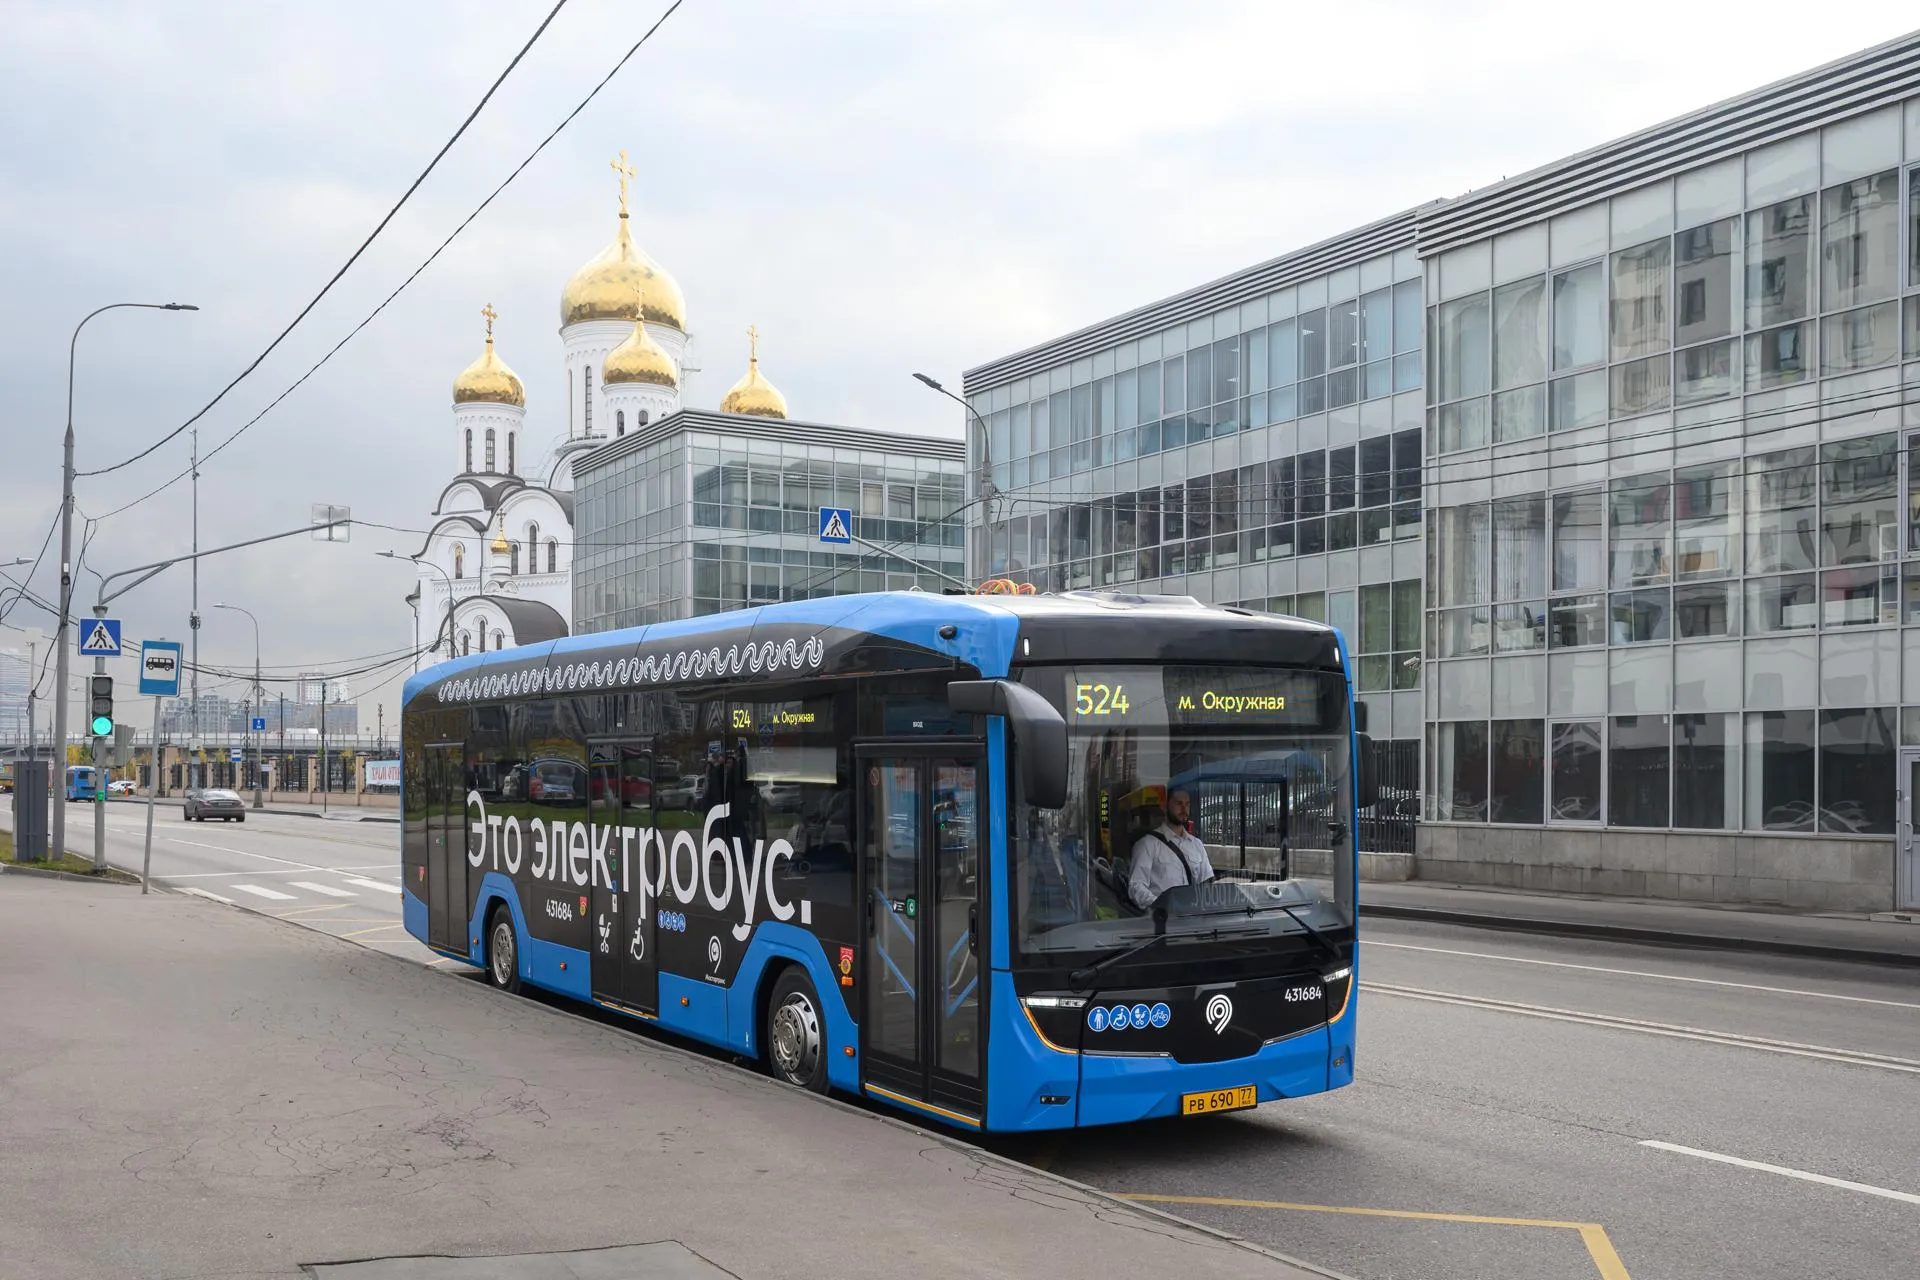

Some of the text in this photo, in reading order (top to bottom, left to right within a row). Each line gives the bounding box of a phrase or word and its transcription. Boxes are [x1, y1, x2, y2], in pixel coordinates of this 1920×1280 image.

[1075, 684, 1285, 715] 524 м. Окружная
[732, 709, 751, 728] 524
[781, 711, 815, 725] Окружная
[467, 790, 811, 942] Это электробус.
[546, 898, 572, 921] 431684
[1284, 986, 1322, 1002] 431684
[1210, 1091, 1234, 1109] 690
[1241, 1087, 1252, 1100] 77
